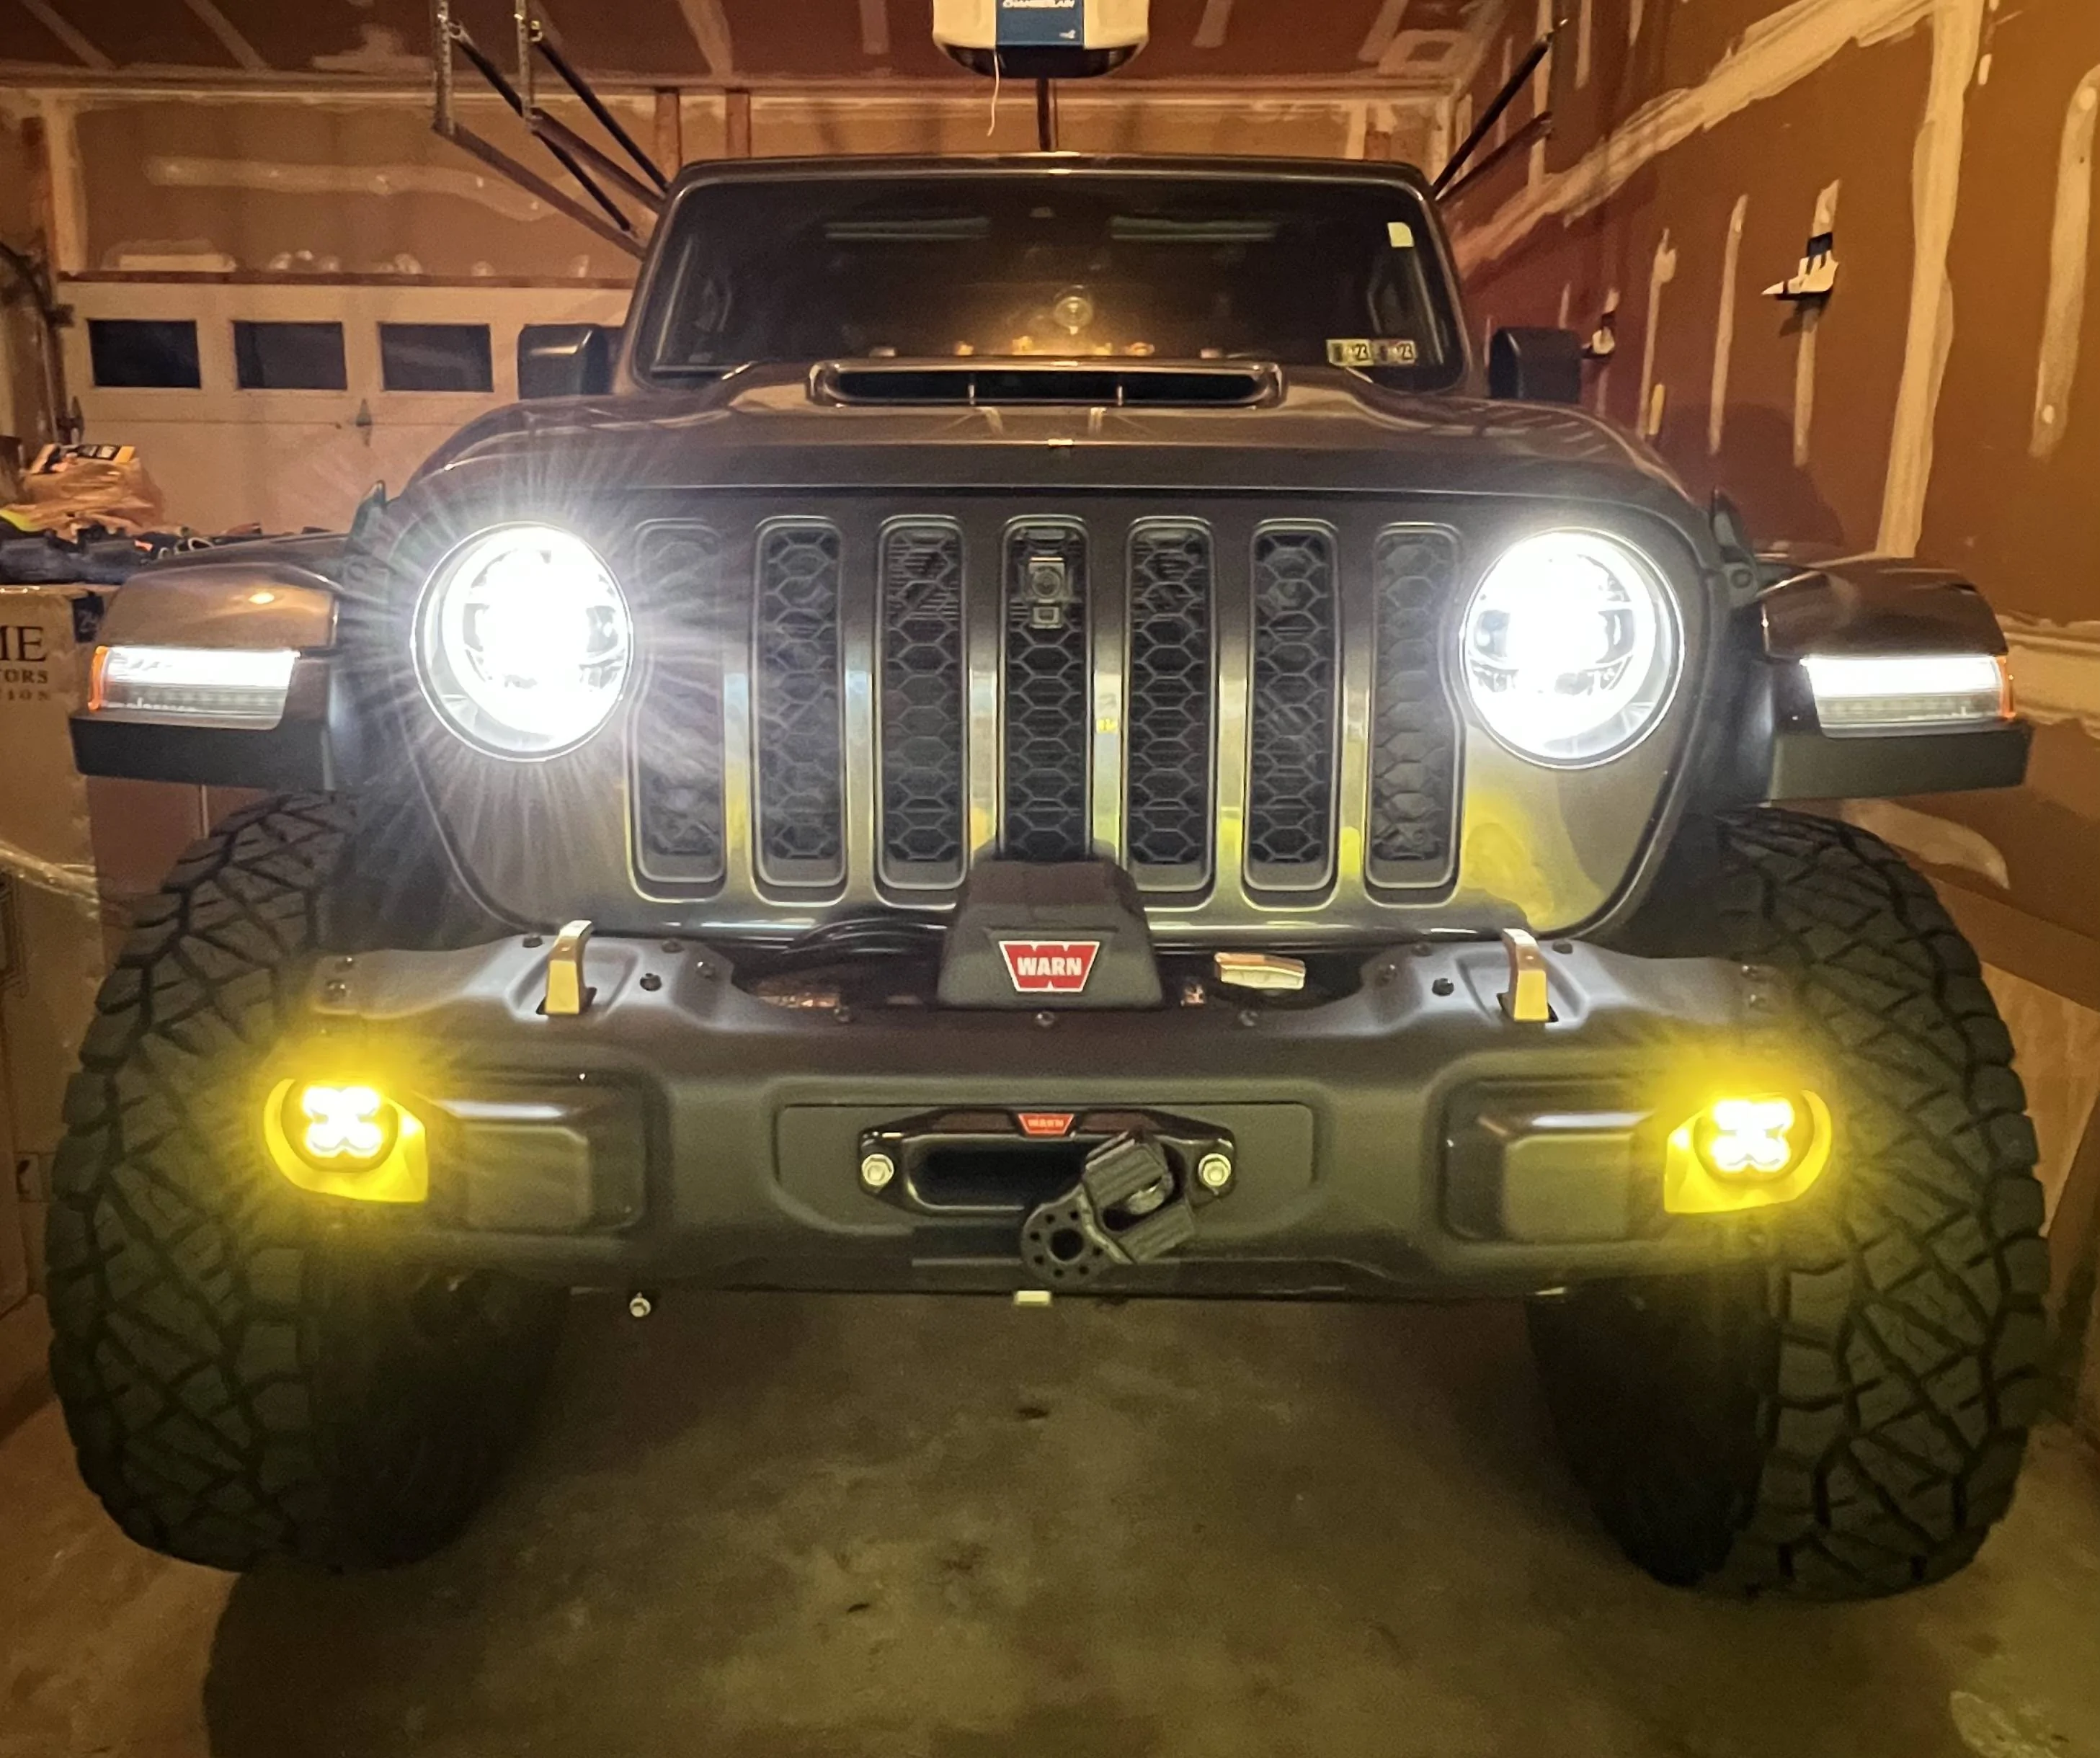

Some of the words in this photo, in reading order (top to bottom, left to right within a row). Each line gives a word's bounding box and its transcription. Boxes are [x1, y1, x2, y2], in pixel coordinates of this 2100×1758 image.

[0, 668, 48, 684] ORS
[0, 689, 50, 701] ION
[1017, 956, 1082, 976] WARN
[1028, 1118, 1064, 1128] WARN
